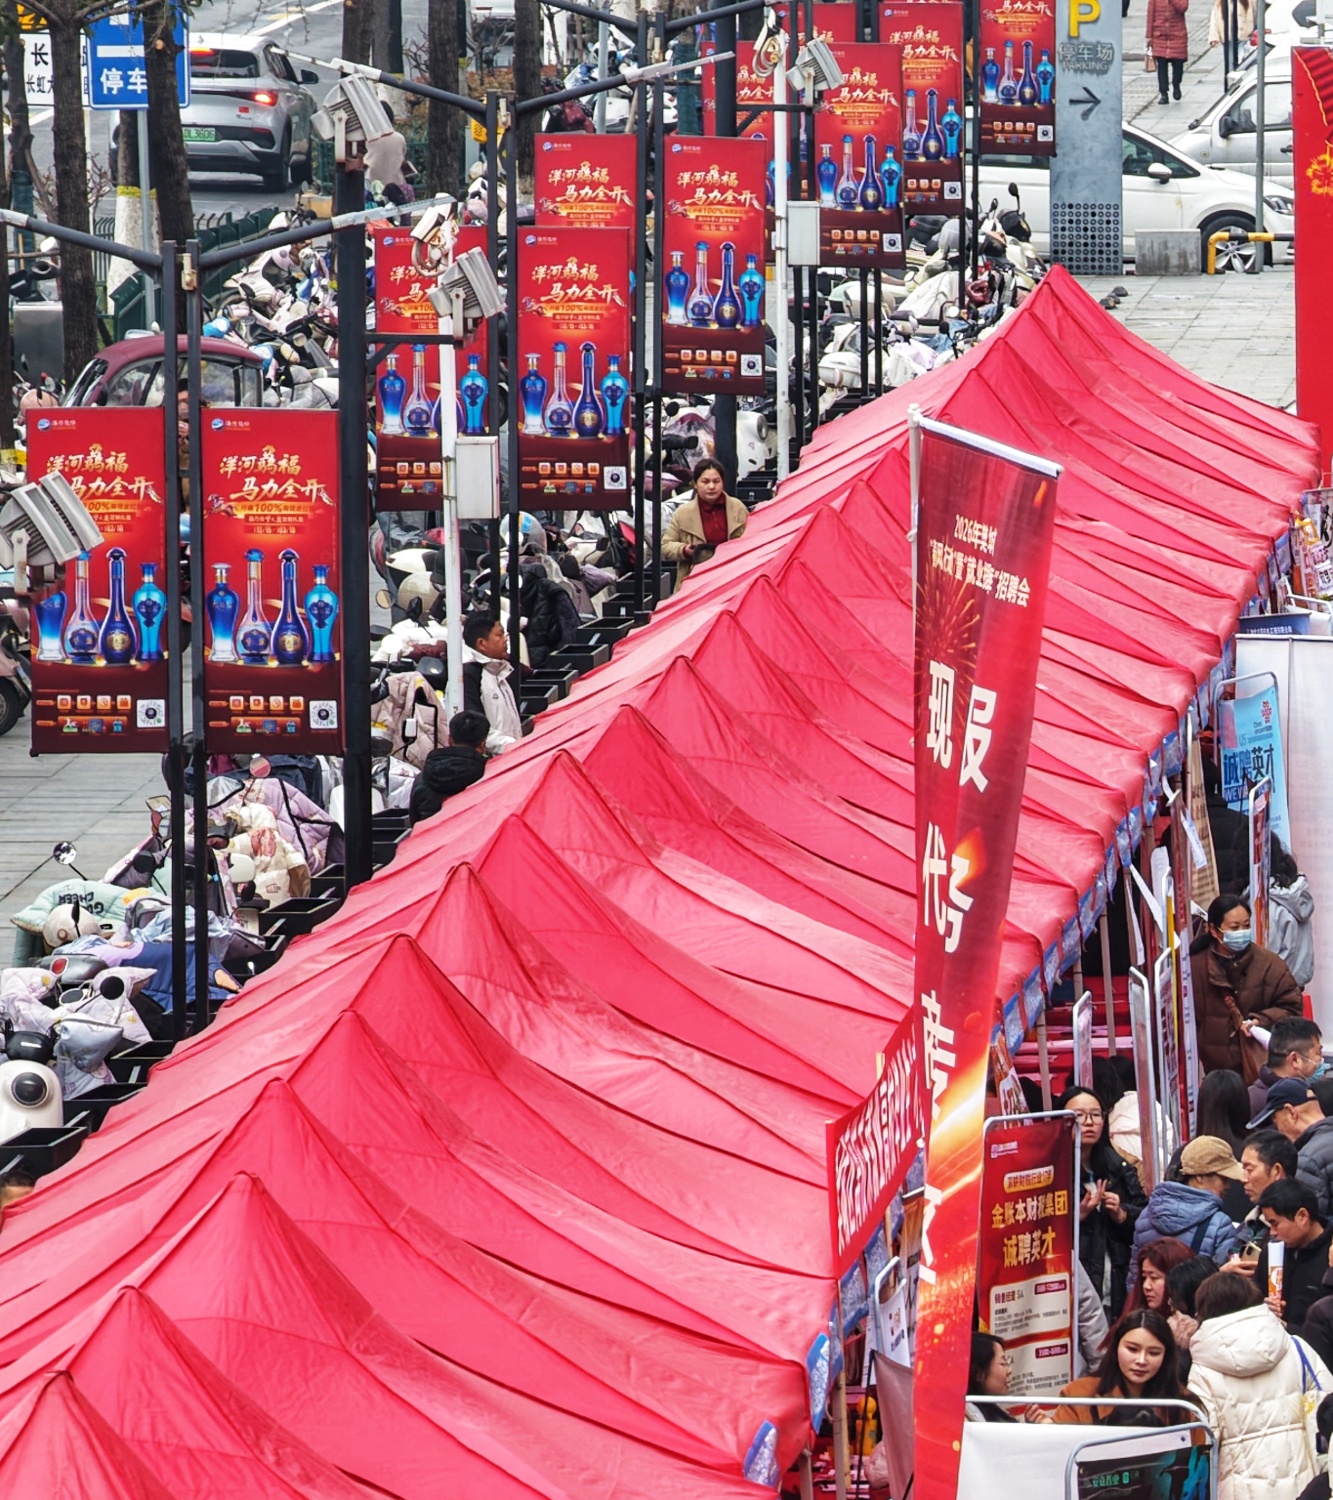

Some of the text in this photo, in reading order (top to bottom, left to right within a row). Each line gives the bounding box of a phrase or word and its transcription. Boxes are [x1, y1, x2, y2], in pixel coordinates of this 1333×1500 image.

[1068, 0, 1101, 37] P
[1002, 1225, 1057, 1269] 诚聘英才
